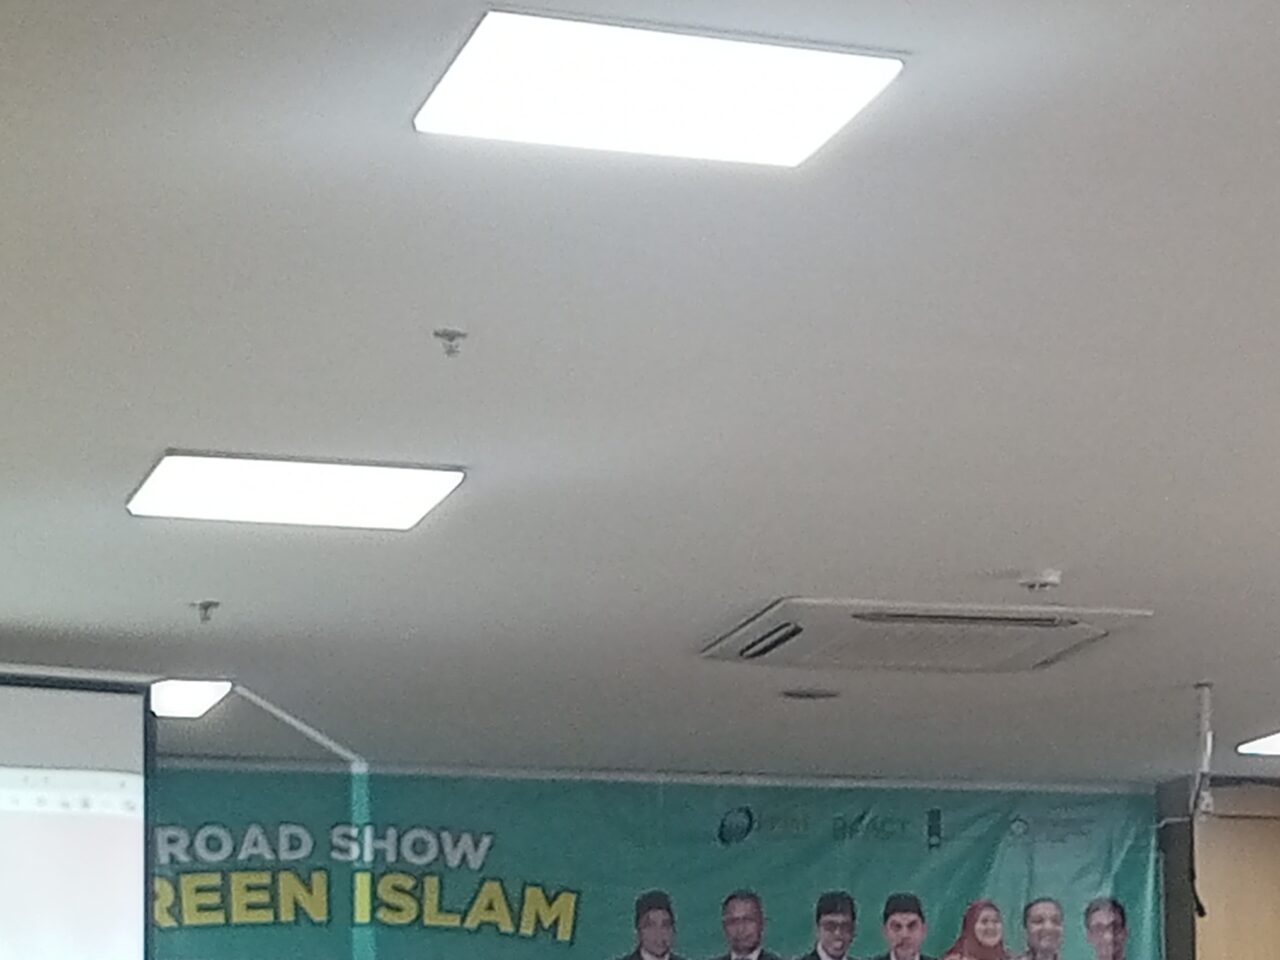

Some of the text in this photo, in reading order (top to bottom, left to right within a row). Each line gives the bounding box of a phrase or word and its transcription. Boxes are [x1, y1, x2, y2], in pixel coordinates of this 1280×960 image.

[154, 822, 492, 870] ROAD SHOW
[353, 872, 580, 942] ISLAM
